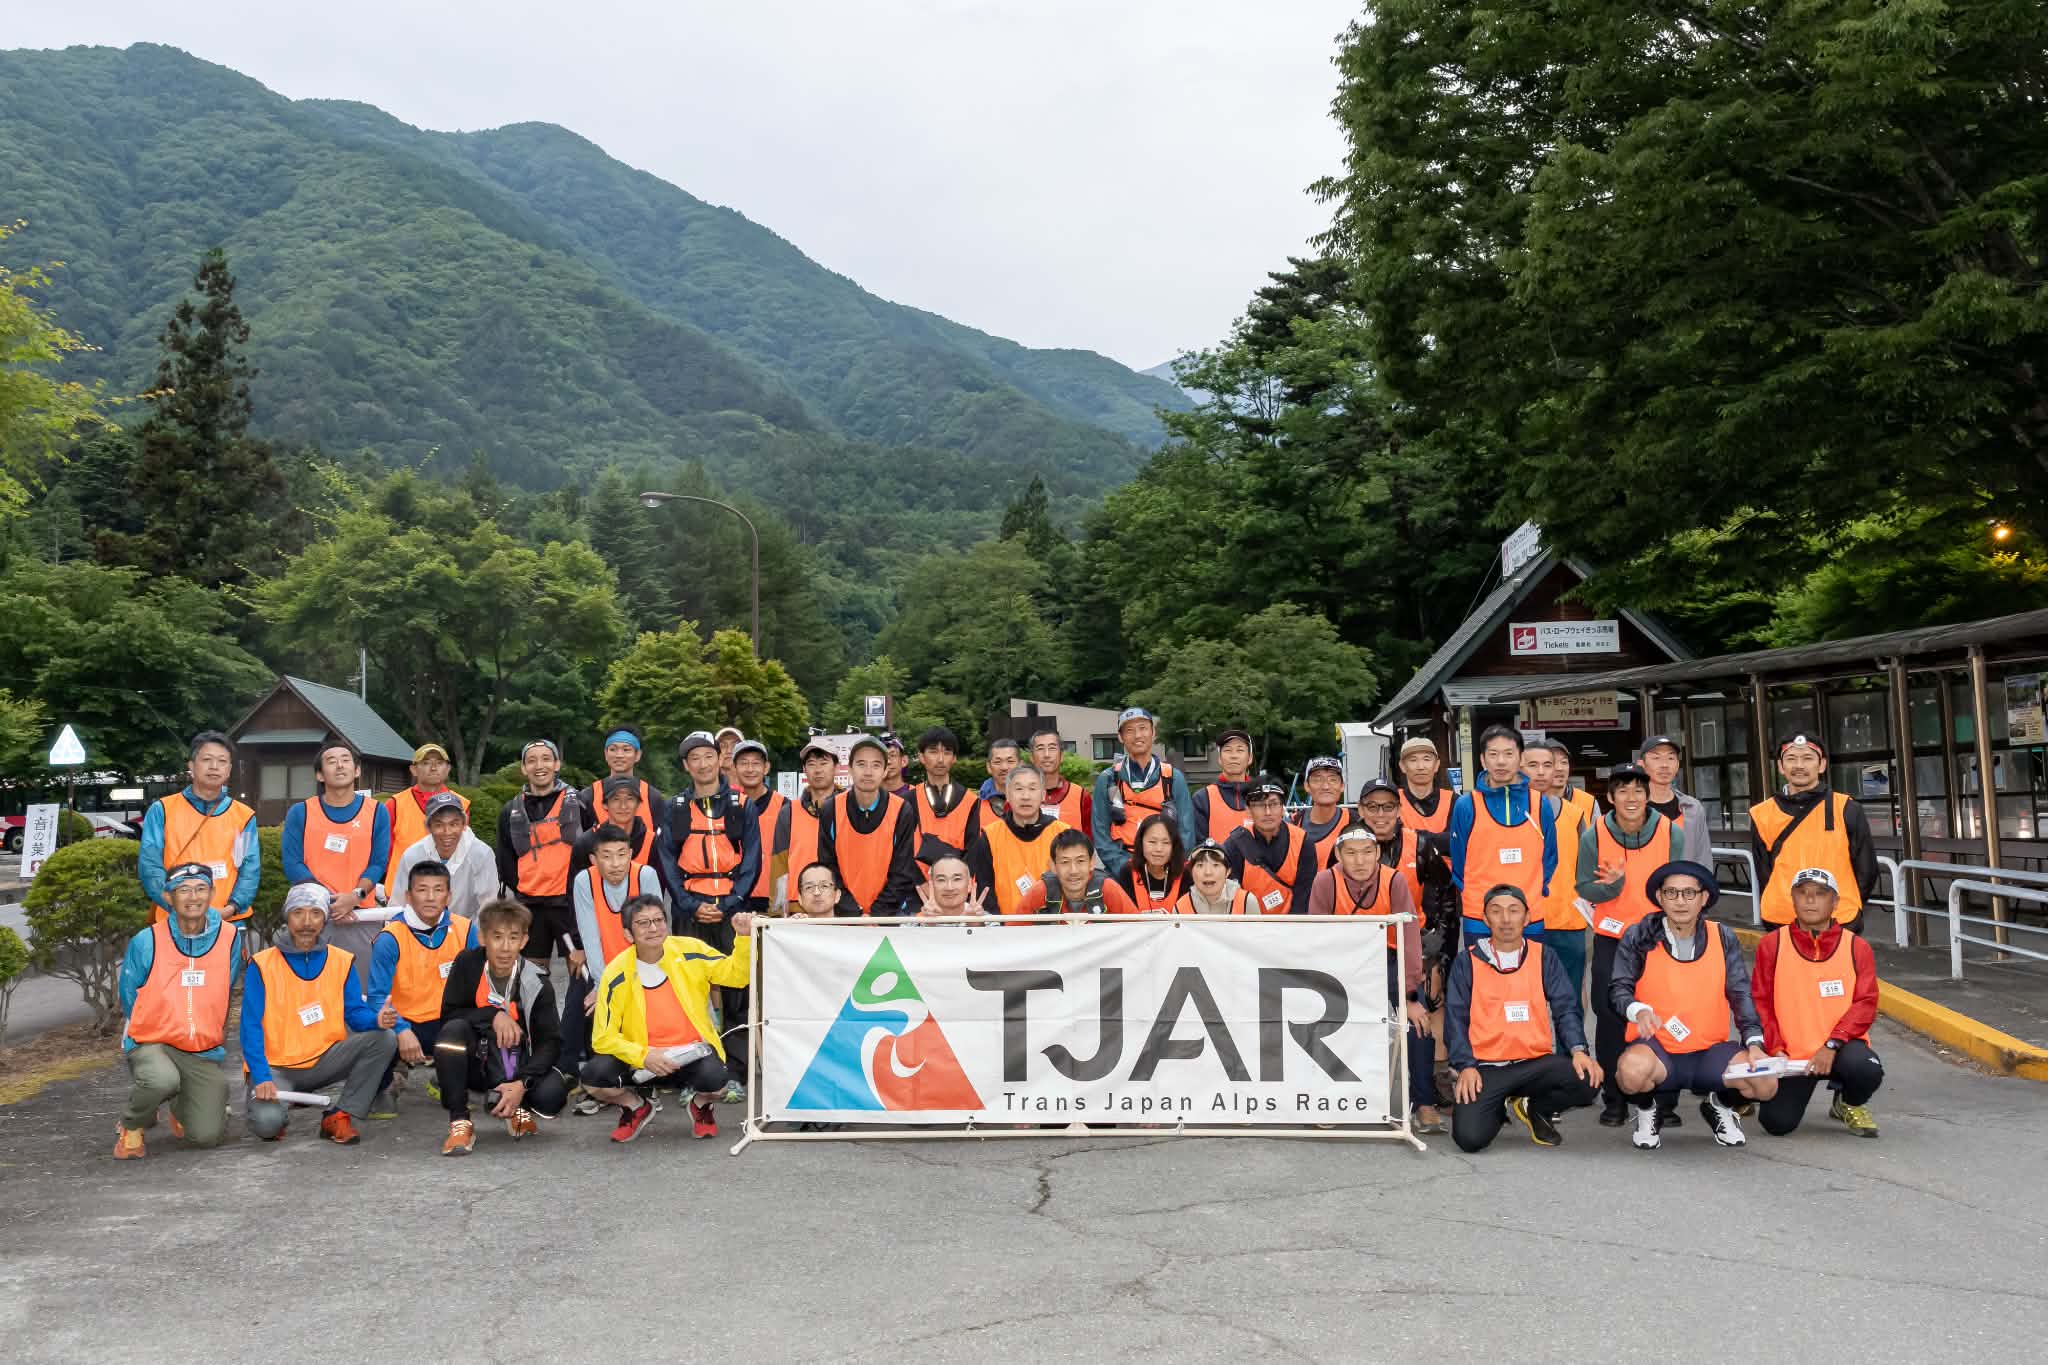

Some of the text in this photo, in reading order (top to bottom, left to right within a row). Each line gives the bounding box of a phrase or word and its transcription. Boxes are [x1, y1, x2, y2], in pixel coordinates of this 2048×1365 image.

[1544, 640, 1569, 649] Tickets
[868, 697, 882, 714] P
[966, 967, 1362, 1082] TJAR
[1003, 1092, 1368, 1115] Trans Japan Alps Race
